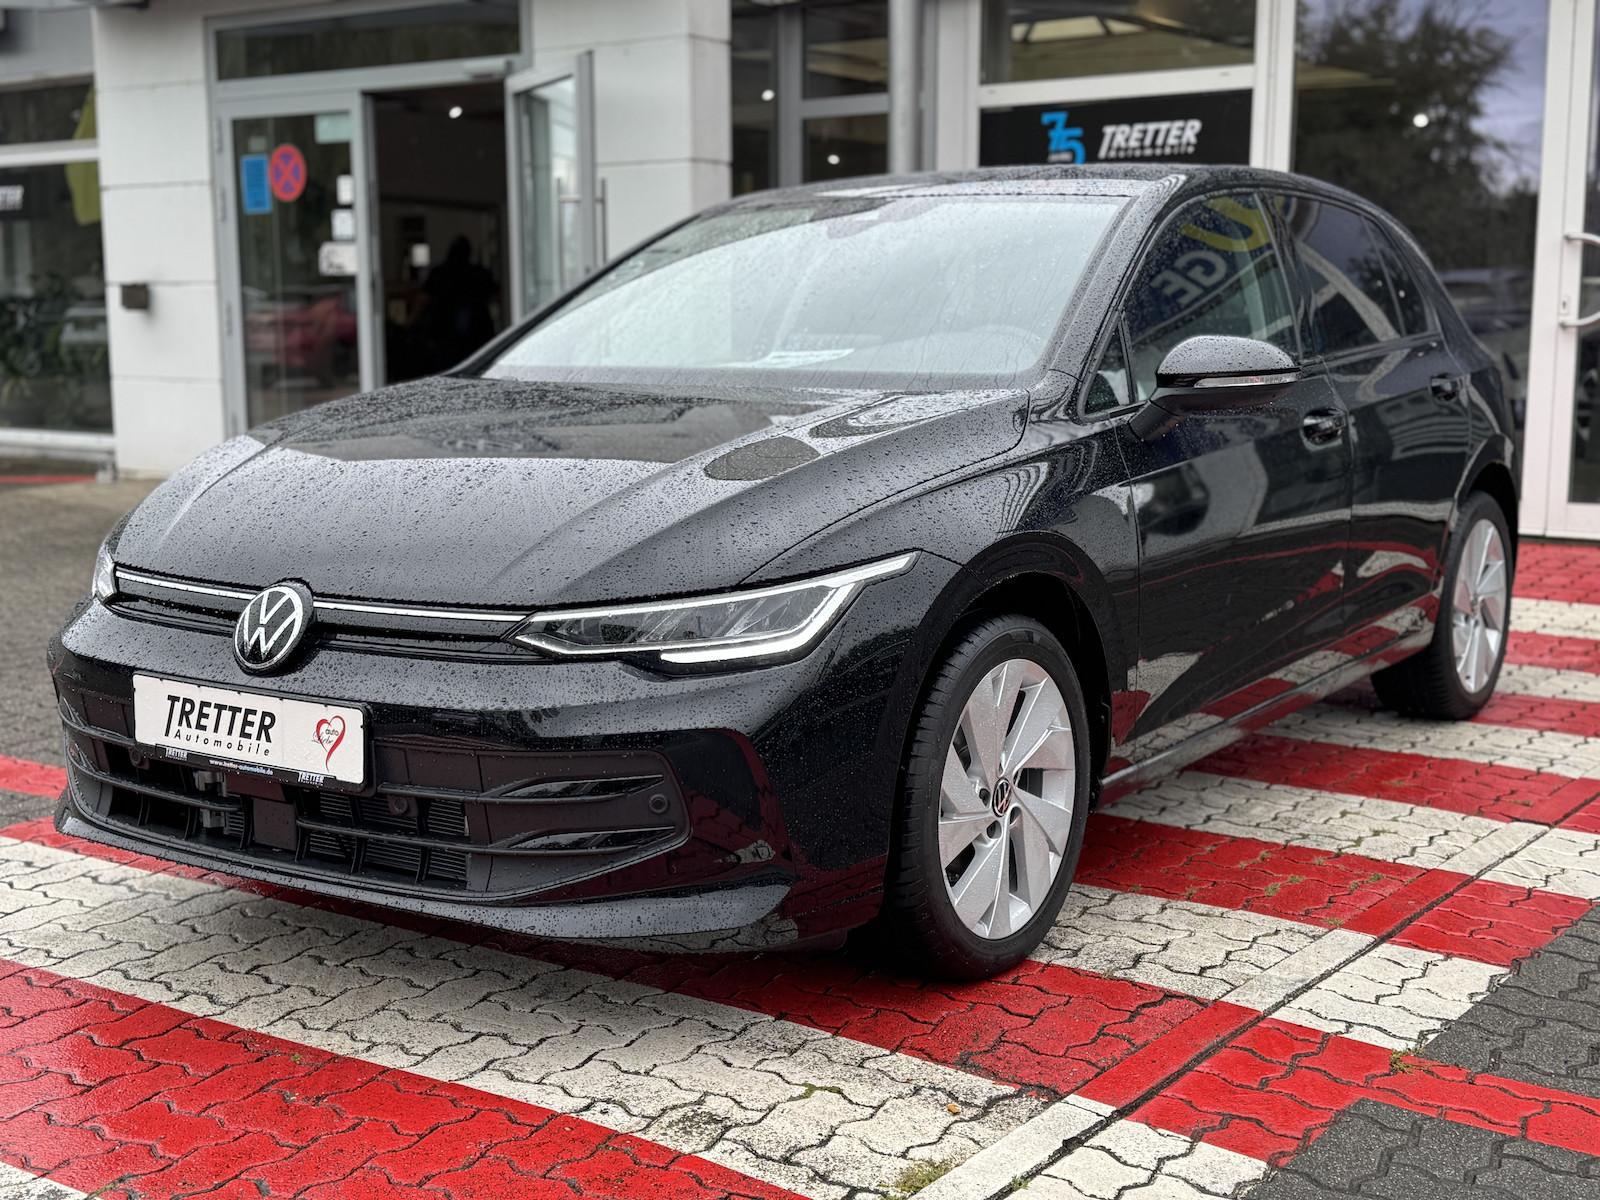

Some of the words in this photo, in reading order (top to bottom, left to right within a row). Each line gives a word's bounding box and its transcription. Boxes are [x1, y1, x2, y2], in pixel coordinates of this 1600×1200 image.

[1040, 110, 1086, 165] 75
[1098, 118, 1202, 160] TRETTER
[164, 694, 276, 743] TRETTER
[325, 728, 340, 737] auto
[174, 728, 270, 757] Automobile
